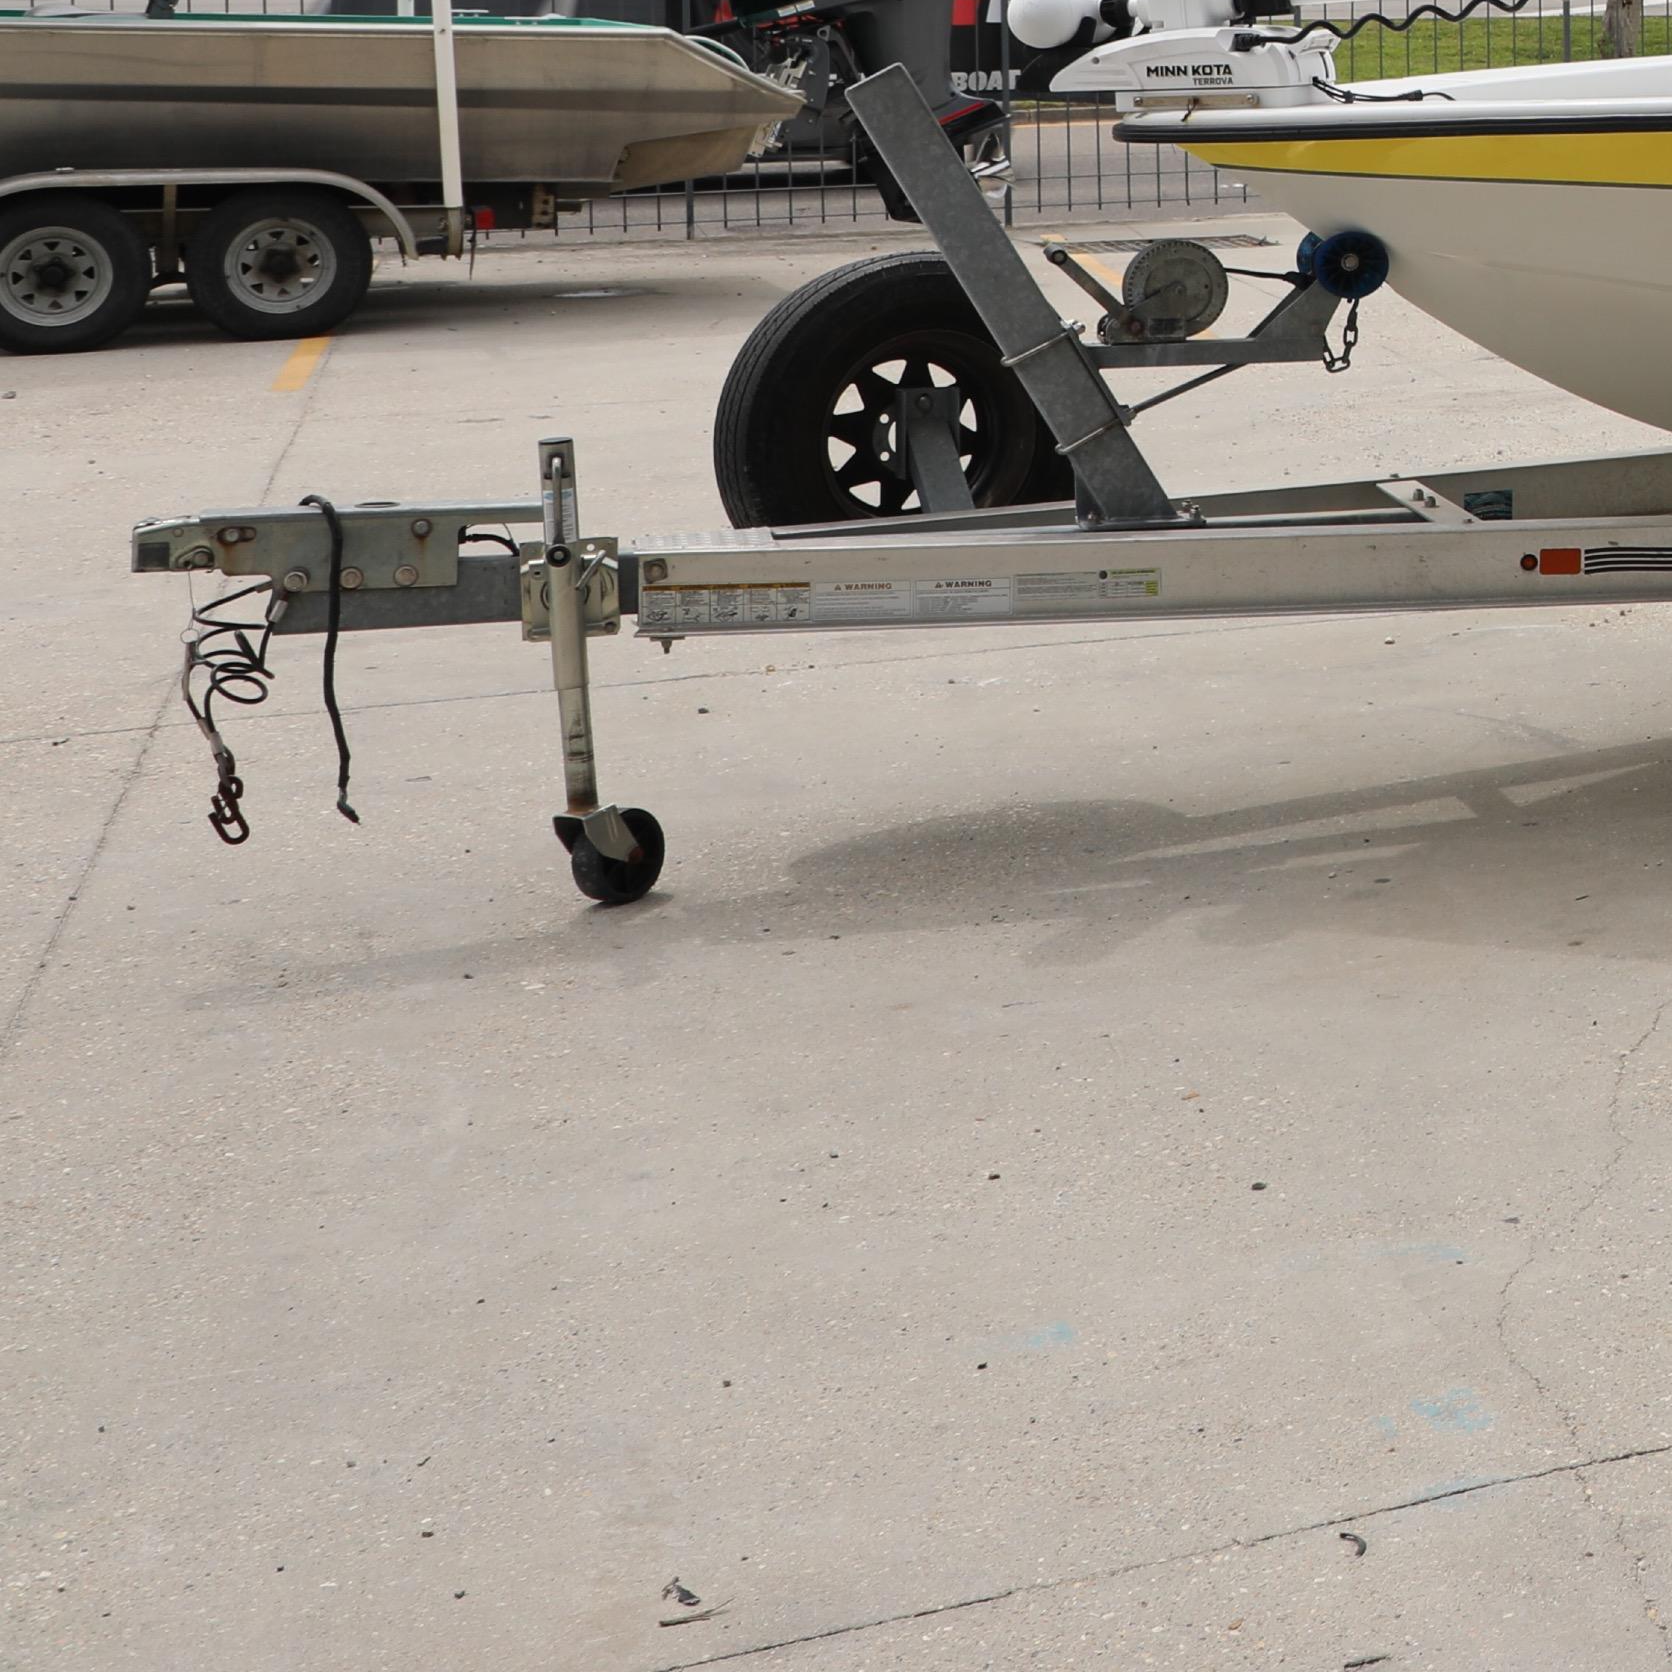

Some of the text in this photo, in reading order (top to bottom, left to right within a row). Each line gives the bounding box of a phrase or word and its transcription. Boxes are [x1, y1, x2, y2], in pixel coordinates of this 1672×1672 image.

[1146, 64, 1233, 77] MINN KOTA
[1193, 77, 1234, 85] TERROVA
[844, 582, 892, 591] WARNING
[945, 580, 992, 589] WARNING
